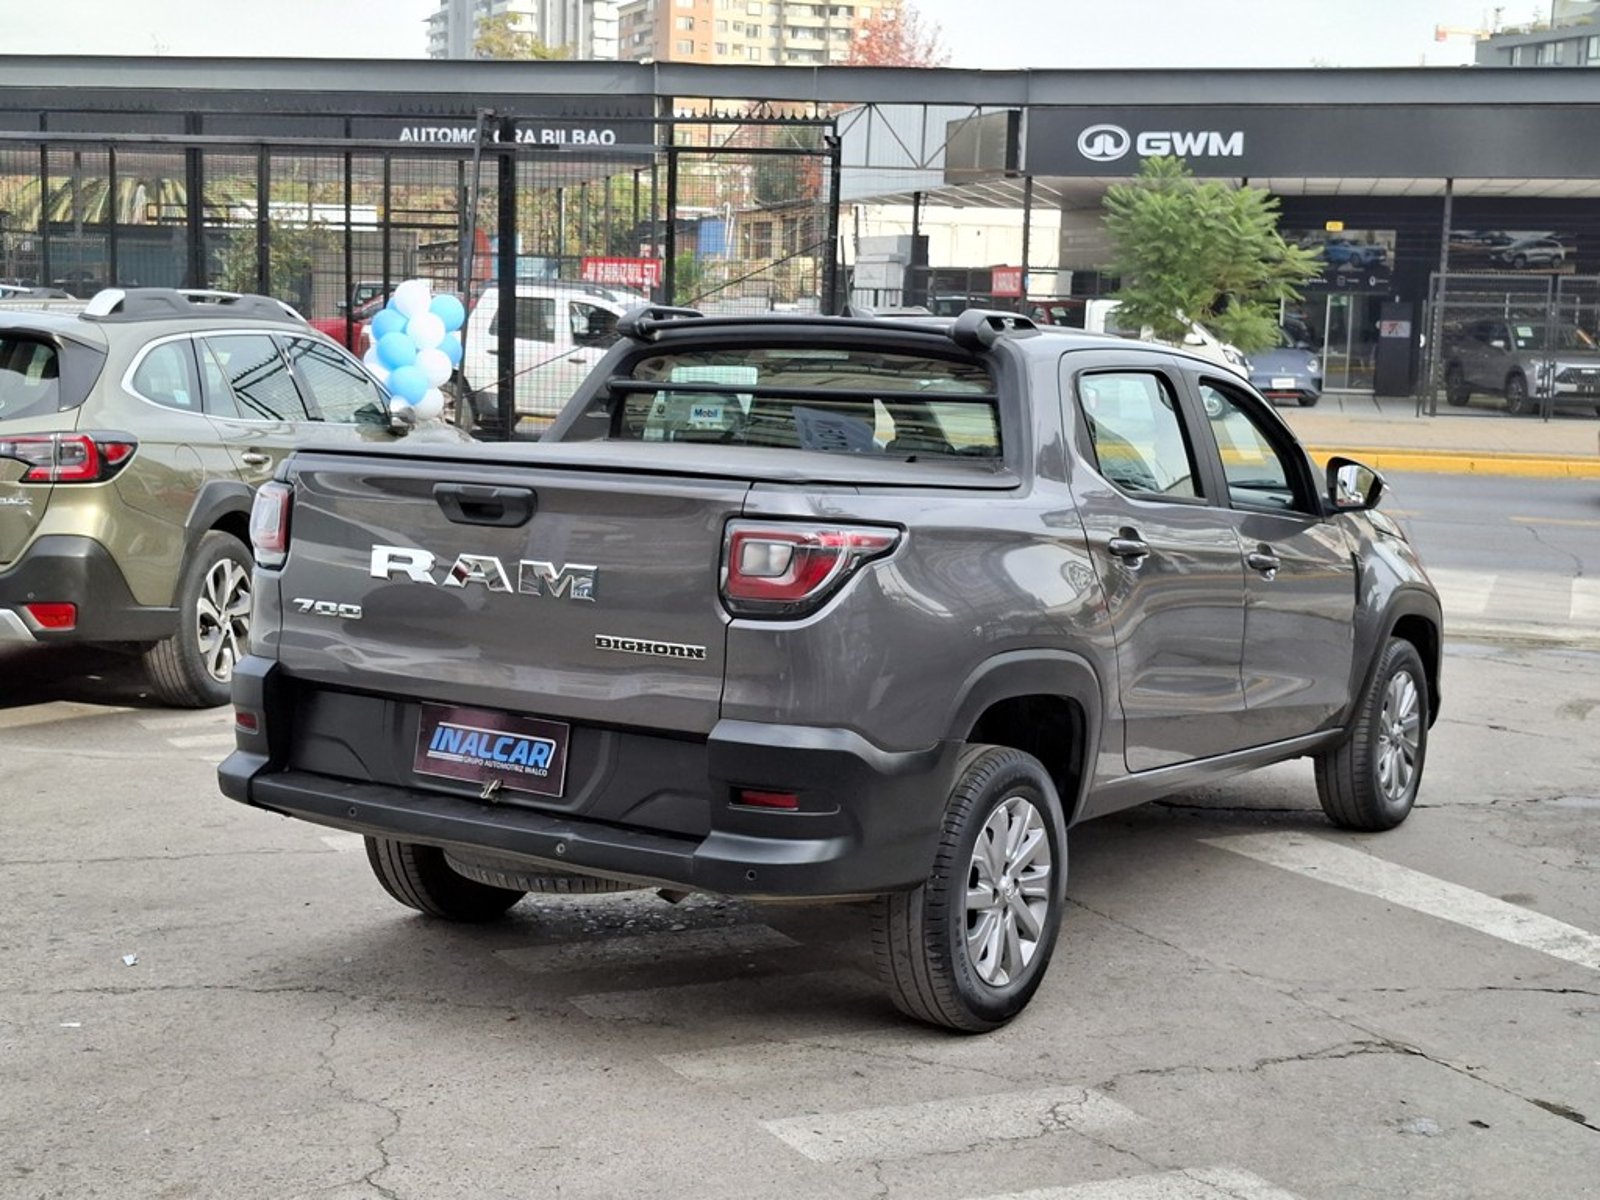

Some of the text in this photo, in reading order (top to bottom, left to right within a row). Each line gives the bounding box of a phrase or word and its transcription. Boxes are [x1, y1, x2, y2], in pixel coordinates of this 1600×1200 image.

[400, 128, 616, 145] AUTOMORA BILBAO
[1136, 131, 1244, 156] GWM
[693, 407, 719, 418] Mobil
[370, 544, 598, 602] RAM
[292, 597, 364, 620] 700
[595, 634, 706, 660] BIGHORN
[429, 726, 550, 768] INALCAR
[463, 756, 484, 766] GRUPO
